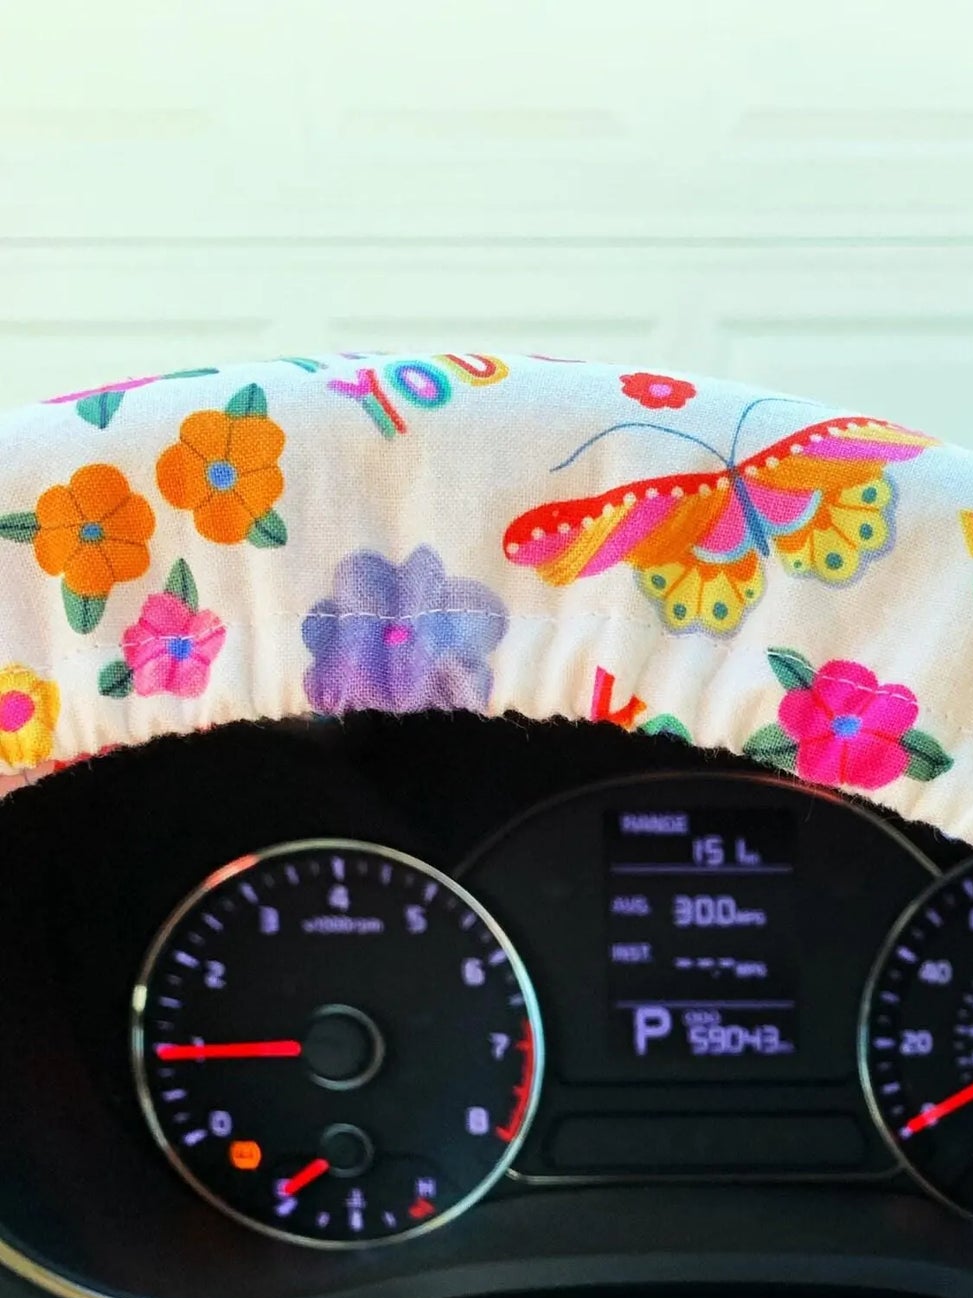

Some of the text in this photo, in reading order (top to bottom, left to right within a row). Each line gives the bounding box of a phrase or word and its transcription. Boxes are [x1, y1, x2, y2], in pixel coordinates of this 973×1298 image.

[327, 352, 510, 440] YOU
[404, 903, 428, 935] 5
[203, 959, 227, 990] 2
[460, 957, 486, 988] 6
[918, 960, 953, 985] 40
[490, 1031, 511, 1060] 7
[634, 1005, 672, 1055] P
[900, 1029, 934, 1055] 20
[208, 1110, 233, 1138] 0
